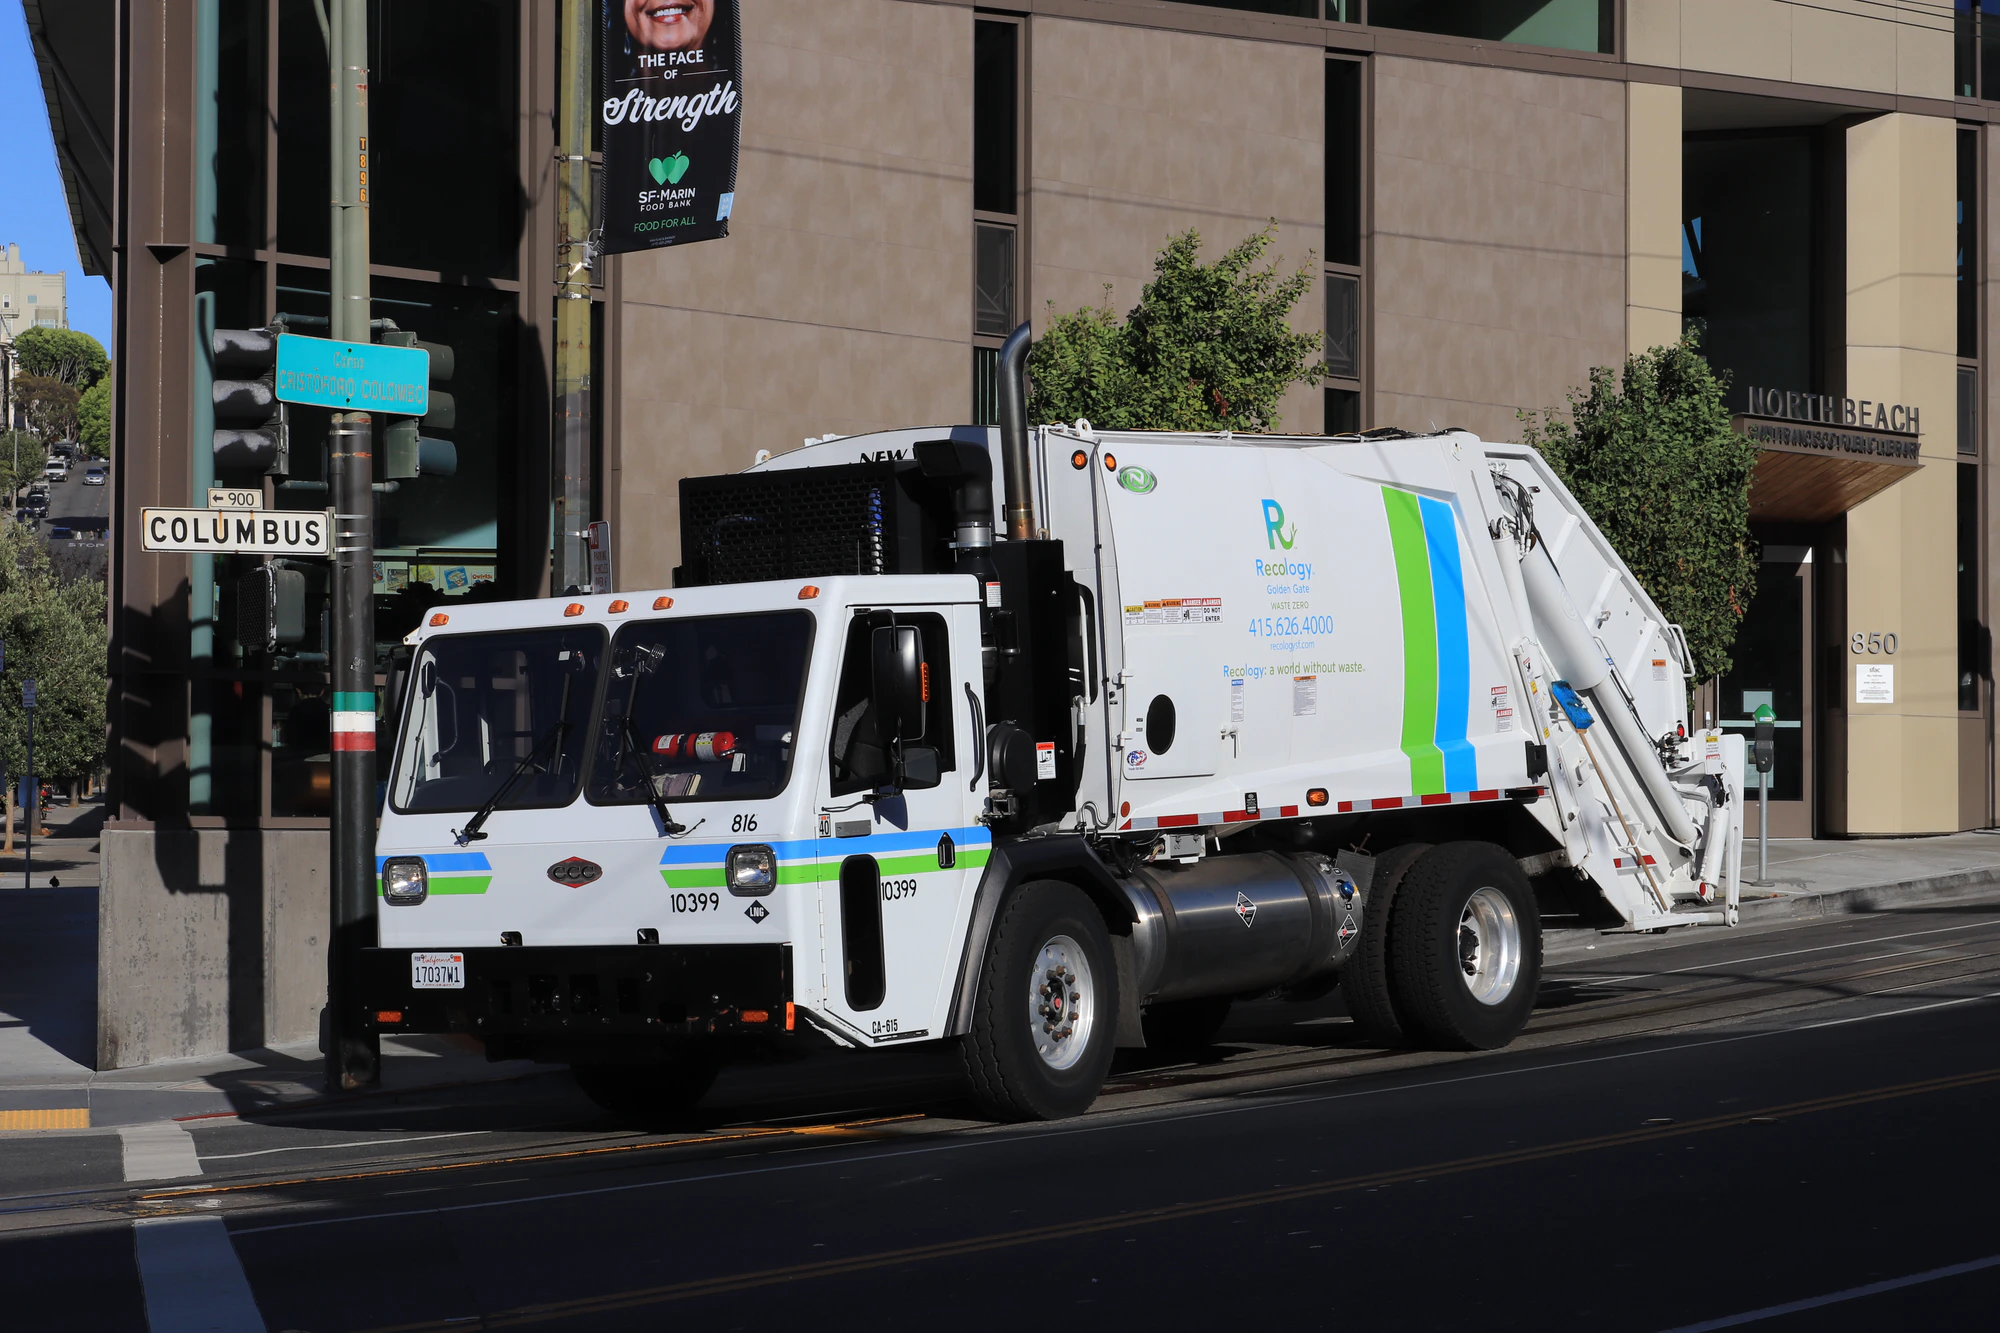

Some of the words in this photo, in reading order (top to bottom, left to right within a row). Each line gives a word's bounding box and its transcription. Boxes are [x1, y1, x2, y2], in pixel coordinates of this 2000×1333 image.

[638, 53, 666, 68] THE
[669, 49, 704, 65] FACE
[663, 69, 678, 80] OF
[603, 80, 739, 132] Strength
[359, 137, 367, 202] T896
[640, 202, 665, 212] FOOD
[668, 199, 692, 209] BANK
[633, 220, 660, 233] FOOD
[661, 218, 679, 229] FOR
[680, 216, 697, 226] ALL
[334, 351, 365, 370] Corso
[361, 379, 425, 405] COLOMBO
[1748, 385, 1835, 424] NORTH
[1841, 397, 1920, 433] BEACH
[228, 492, 254, 506] 900
[150, 516, 321, 546] COLUMBUS
[1255, 557, 1312, 581] Recology
[1266, 584, 1291, 595] Golden
[1293, 584, 1310, 594] Gate
[1271, 602, 1291, 611] WASTE
[1292, 601, 1310, 610] ZERO
[1248, 615, 1334, 637] 415.626.4000
[1270, 640, 1315, 652] recologysf.com
[1851, 632, 1898, 655] 850
[1223, 663, 1267, 680] Recology:
[1269, 666, 1275, 675] a
[1277, 662, 1301, 675] world
[1303, 661, 1336, 674] without
[731, 813, 758, 833] 816
[819, 820, 830, 835] 40
[553, 866, 595, 880] CCC
[881, 879, 917, 901] 10399
[671, 892, 719, 913] 10399
[749, 907, 764, 917] LNG
[415, 966, 460, 983] 17037W1
[872, 1019, 898, 1034] CA-615
